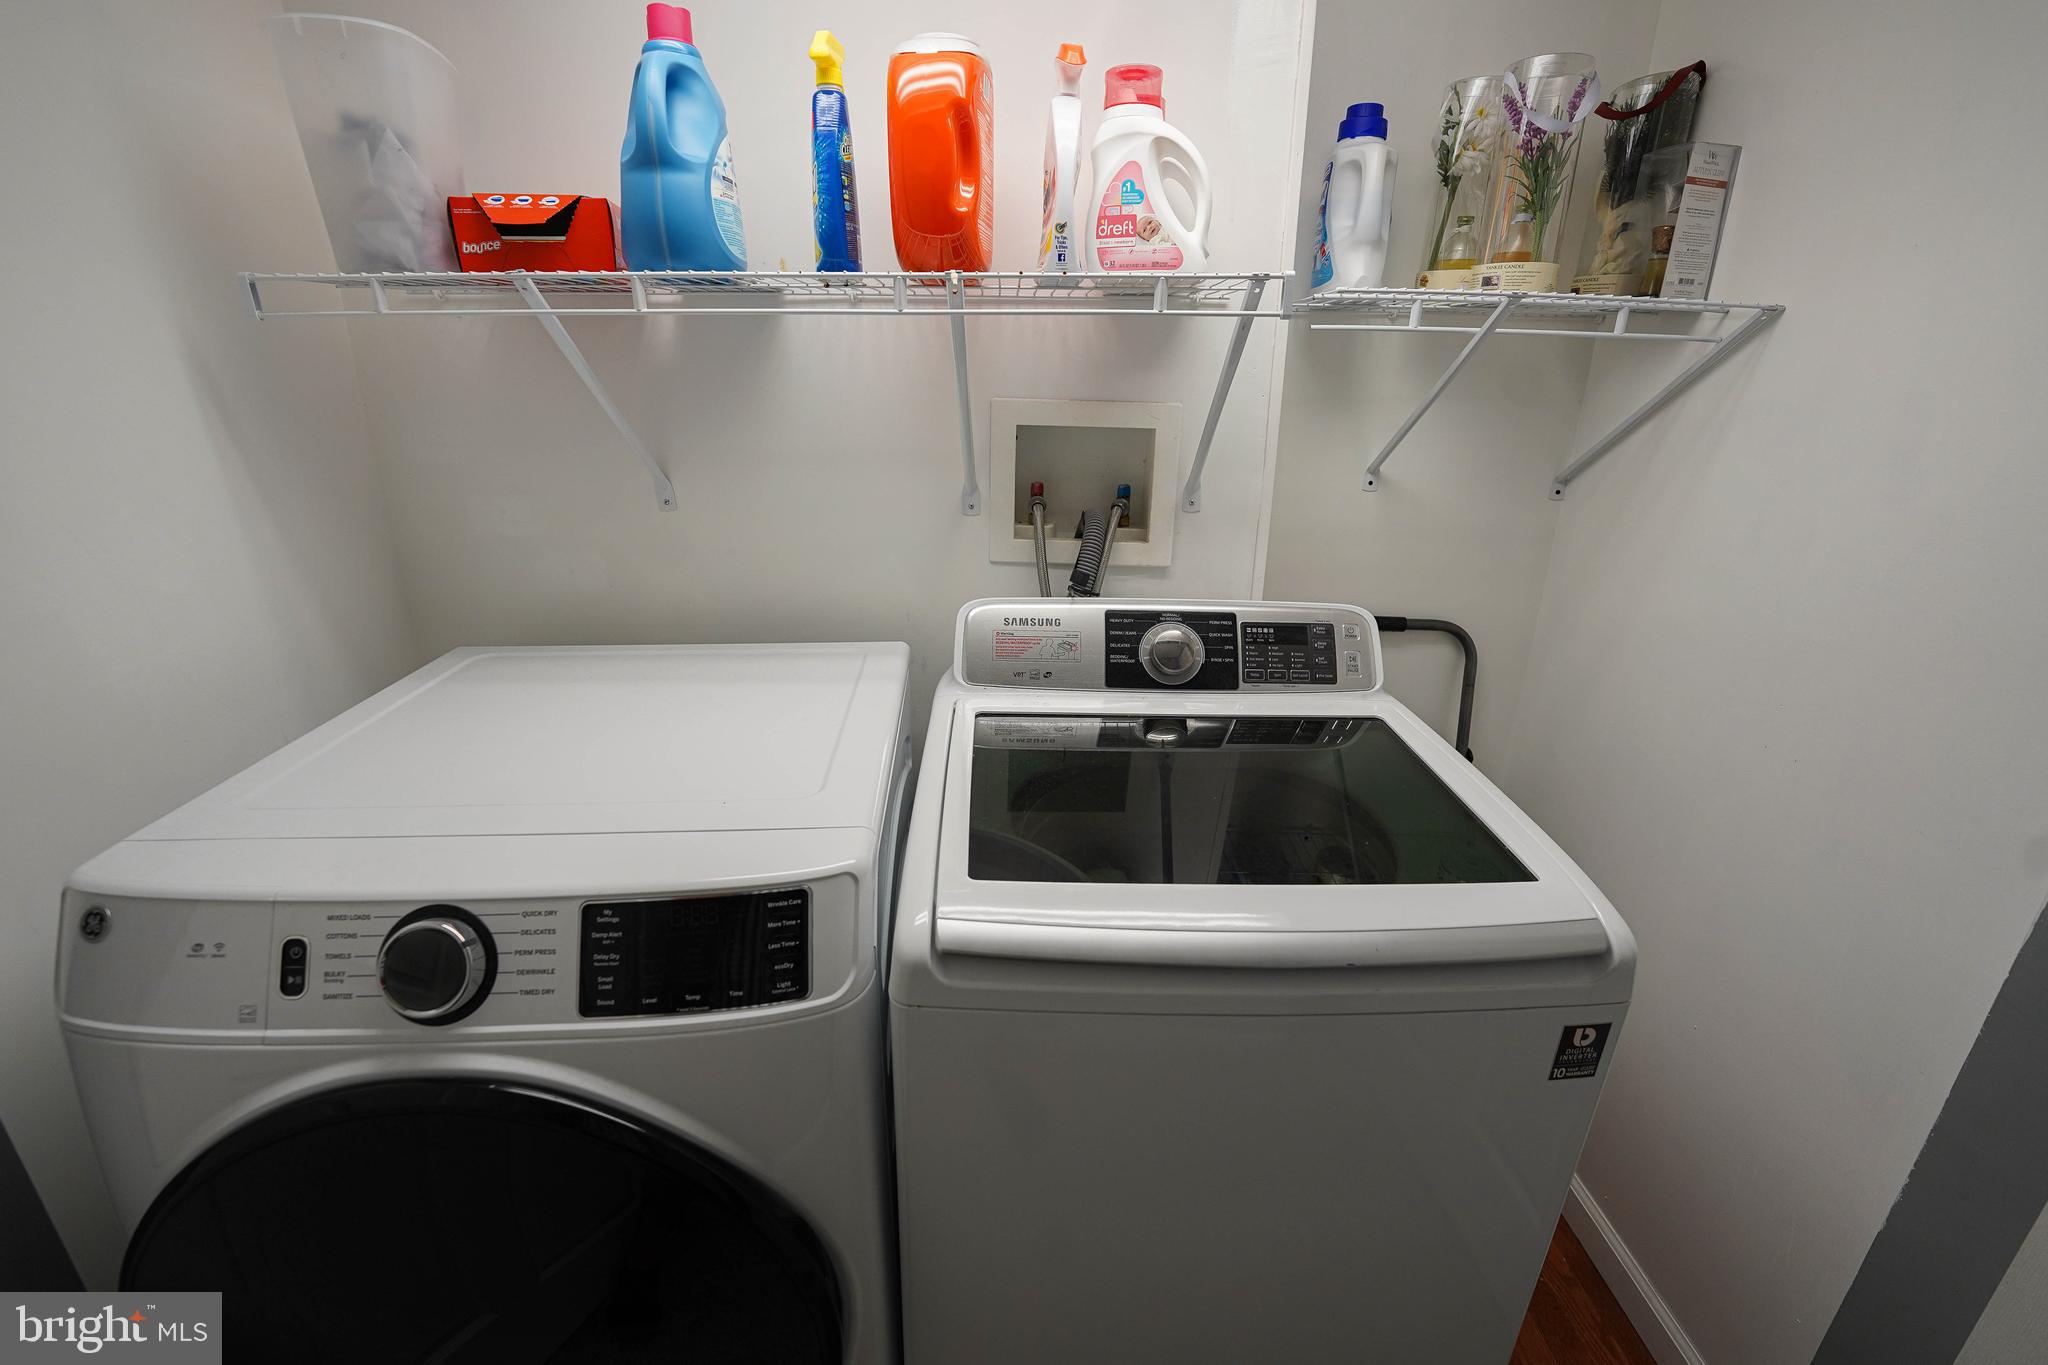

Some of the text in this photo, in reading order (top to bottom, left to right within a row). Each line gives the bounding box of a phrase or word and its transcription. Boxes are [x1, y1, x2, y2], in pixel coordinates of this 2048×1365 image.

[1098, 219, 1134, 236] dreft
[463, 241, 501, 254] bounce
[1003, 617, 1062, 628] SAMSUNG
[350, 913, 372, 921] LOADS
[521, 910, 559, 919] QUICK DRY
[603, 909, 612, 917] My
[768, 921, 781, 929] More
[326, 932, 358, 940] COTTONS
[520, 929, 556, 937] DELICATES
[325, 952, 352, 960] TOWELS
[514, 948, 556, 957] PERM PRESS
[516, 968, 556, 976] DEWRINKLE
[777, 980, 792, 988] Light
[323, 992, 353, 1000] SANITIZE
[519, 988, 555, 997] TIMED DRY
[685, 994, 701, 1002] Temp
[1559, 1053, 1597, 1061] INVERTER
[1553, 1067, 1566, 1078] 10
